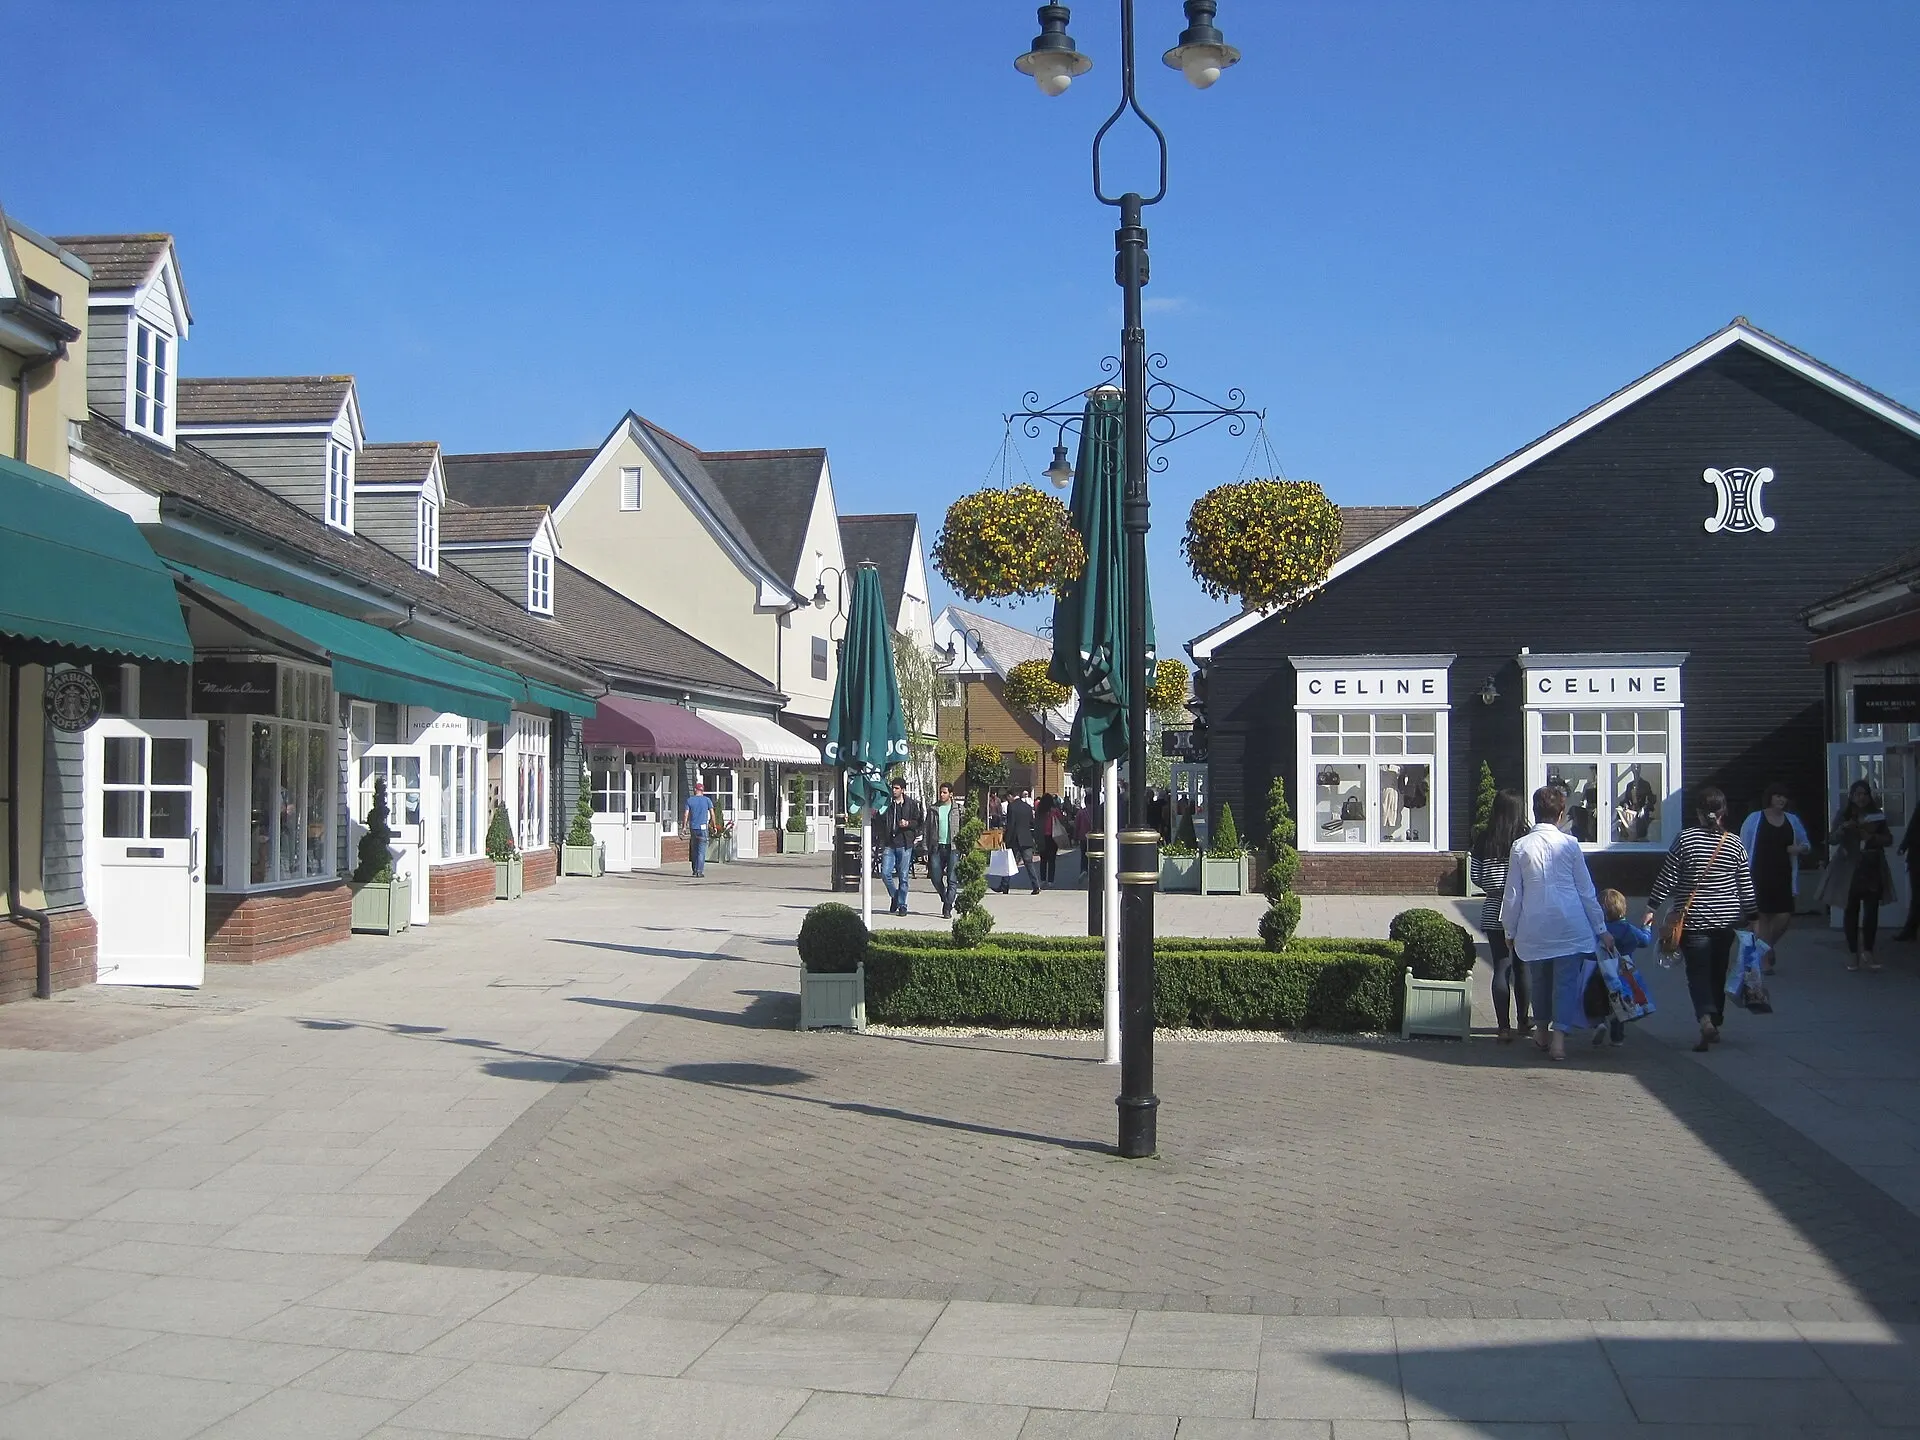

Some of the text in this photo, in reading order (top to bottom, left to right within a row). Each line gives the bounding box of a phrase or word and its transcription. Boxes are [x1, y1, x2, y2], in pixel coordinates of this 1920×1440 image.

[46, 672, 100, 699] STARBUCKS
[1308, 679, 1434, 695] CELINE
[1538, 677, 1666, 693] CELINE
[51, 713, 90, 730] COFFEE
